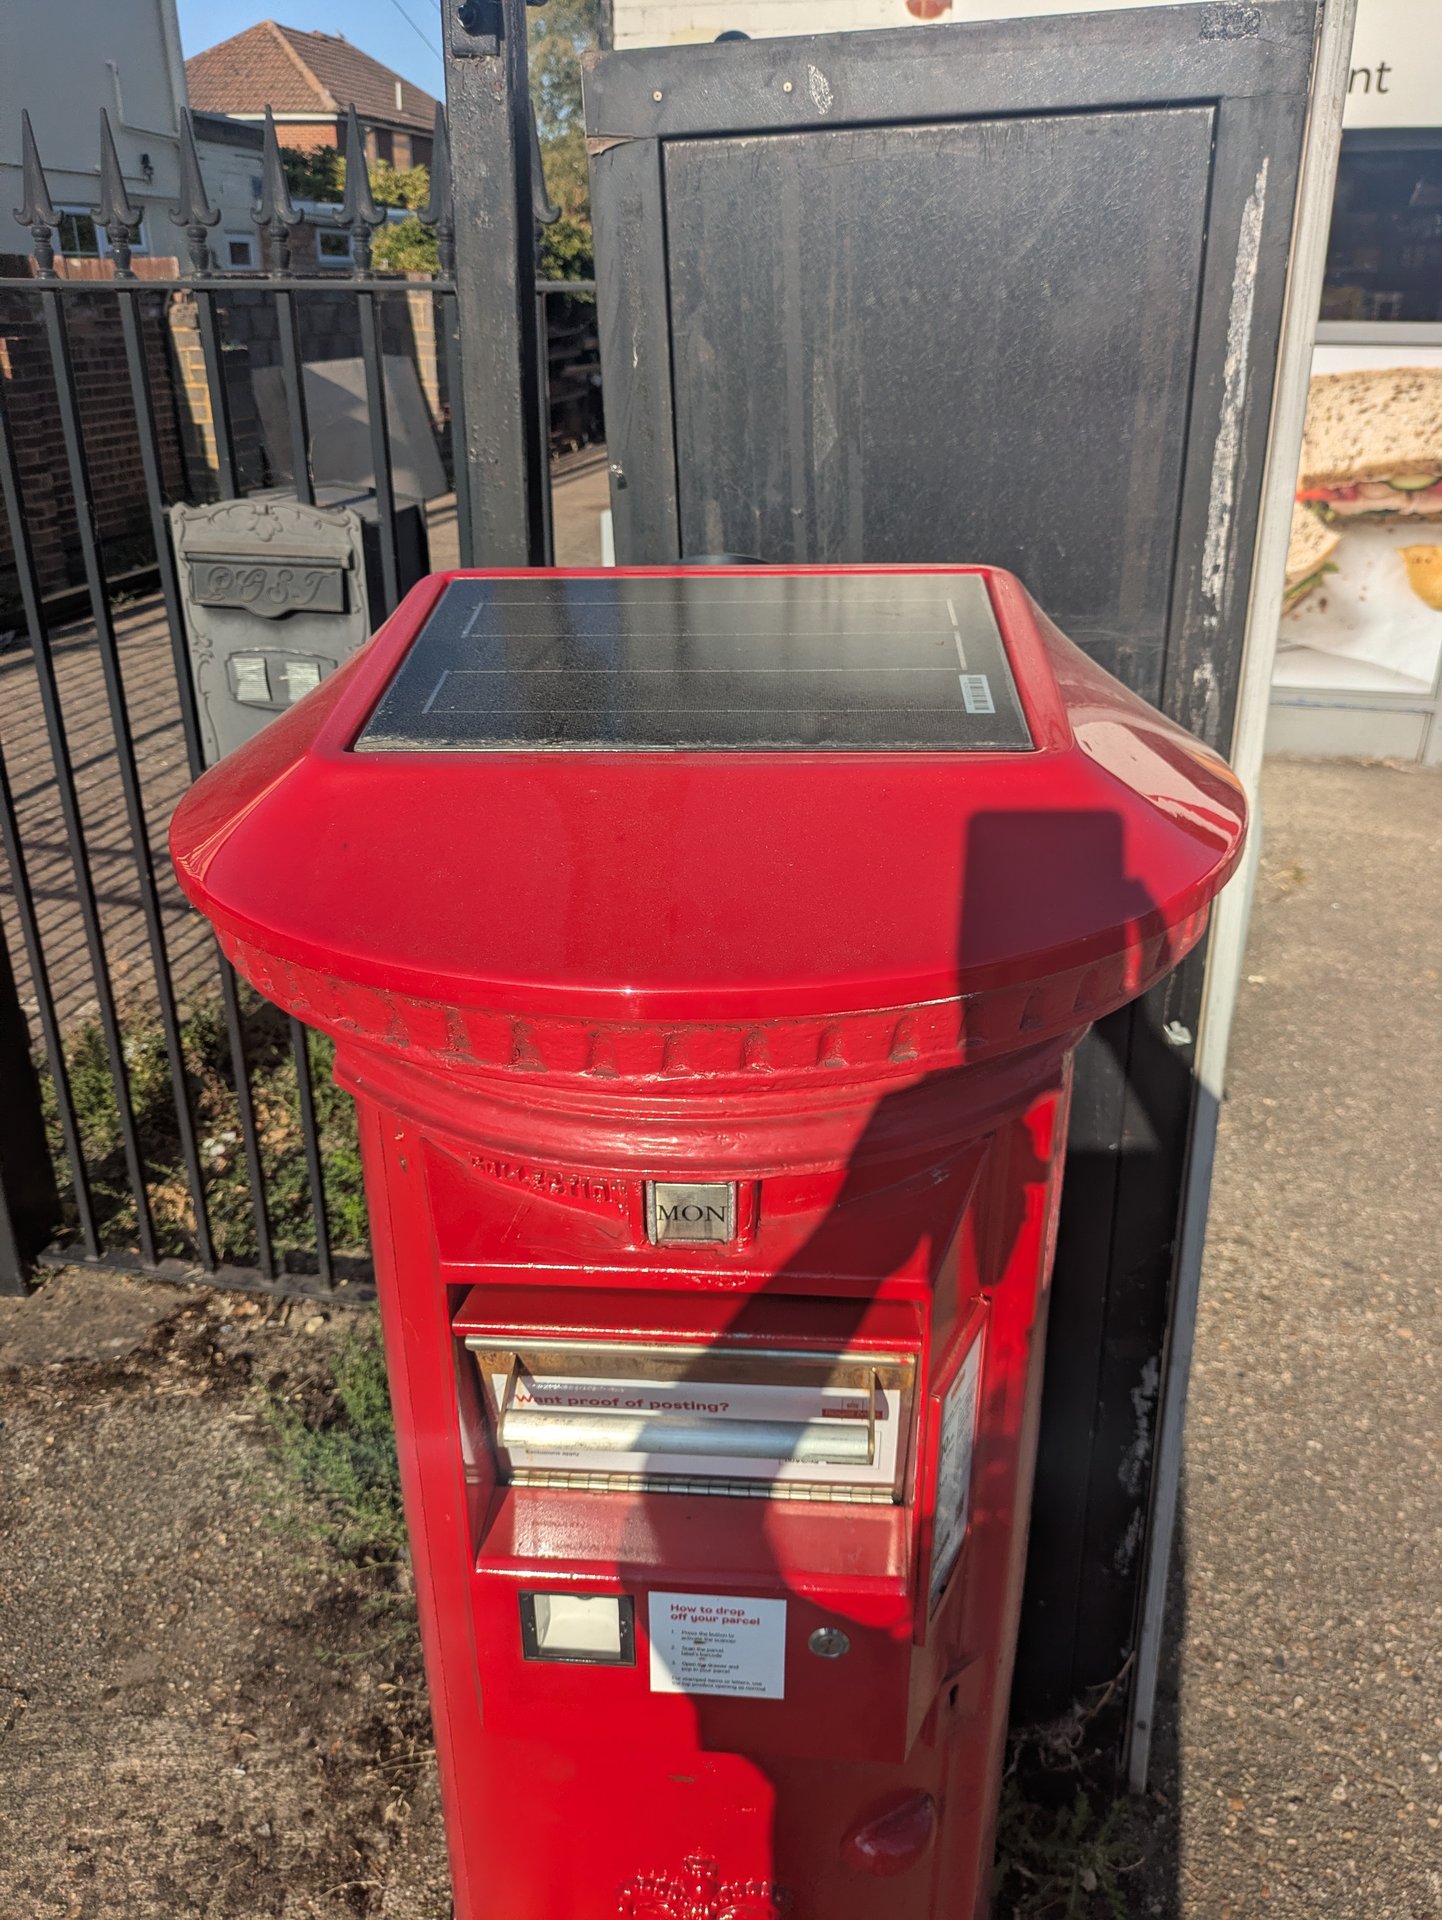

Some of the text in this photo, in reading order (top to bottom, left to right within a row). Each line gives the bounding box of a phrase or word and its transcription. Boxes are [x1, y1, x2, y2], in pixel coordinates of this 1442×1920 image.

[205, 565, 337, 605] POST
[657, 1203, 727, 1223] MON
[514, 1393, 730, 1413] Want proof of posting?
[670, 1603, 746, 1617] How to drop
[670, 1613, 761, 1625] off your parcel
